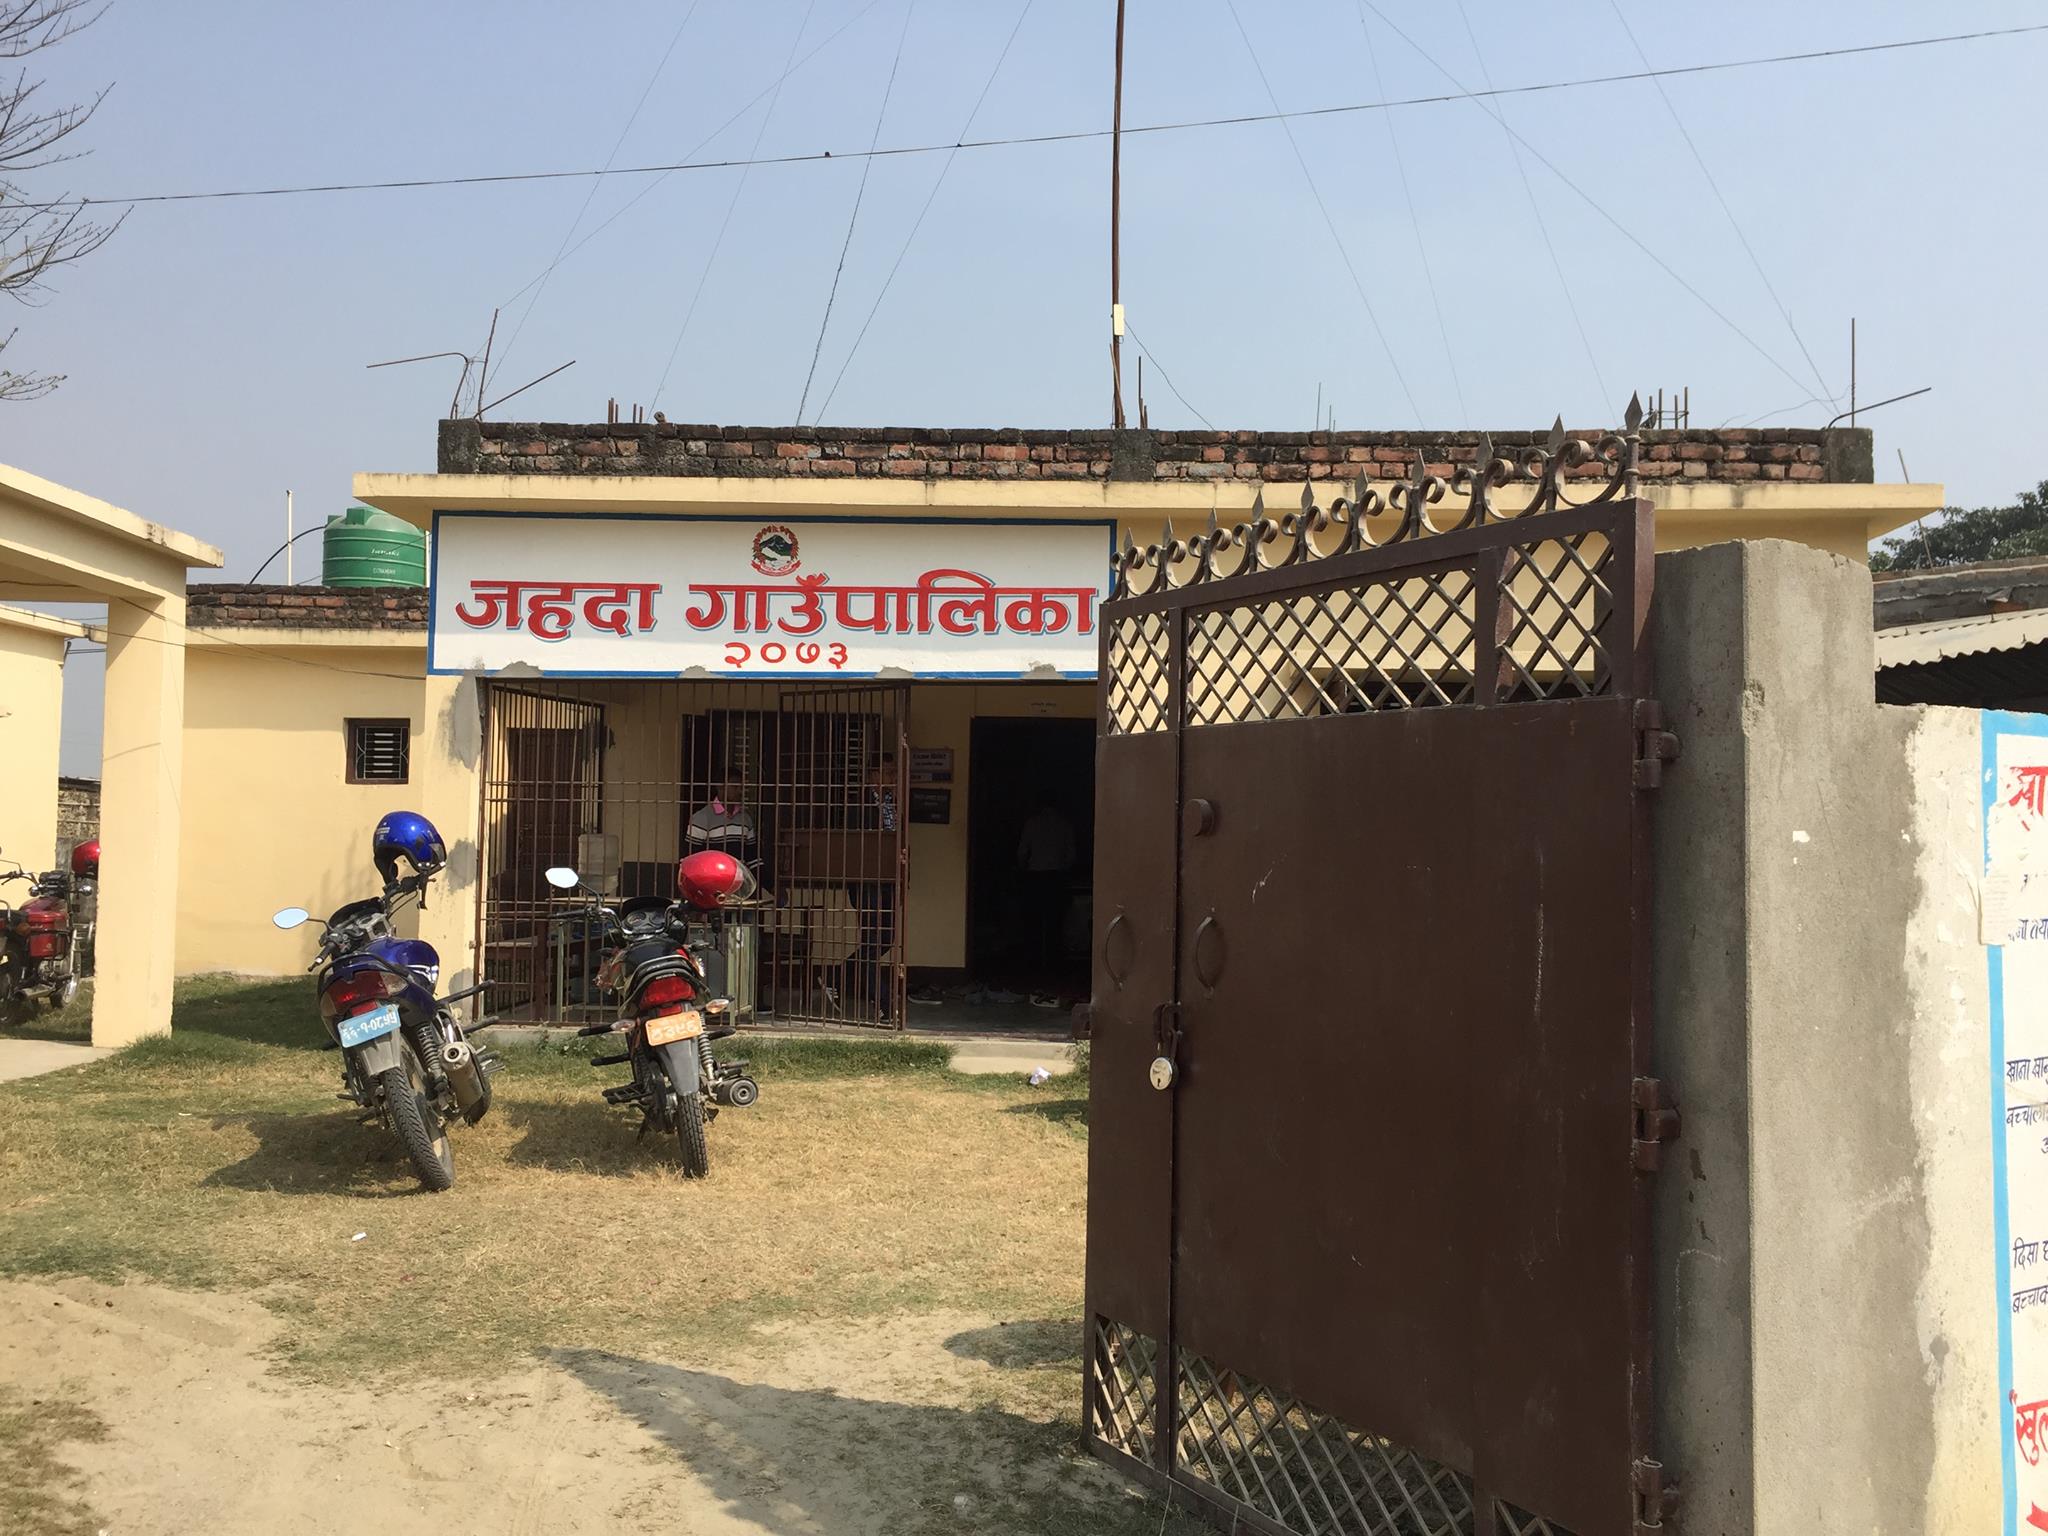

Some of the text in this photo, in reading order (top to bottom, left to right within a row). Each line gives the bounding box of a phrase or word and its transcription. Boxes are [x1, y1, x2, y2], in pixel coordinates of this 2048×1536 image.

[455, 568, 1097, 638] जहदा गाउँपालिका
[723, 641, 849, 669] २०७३
